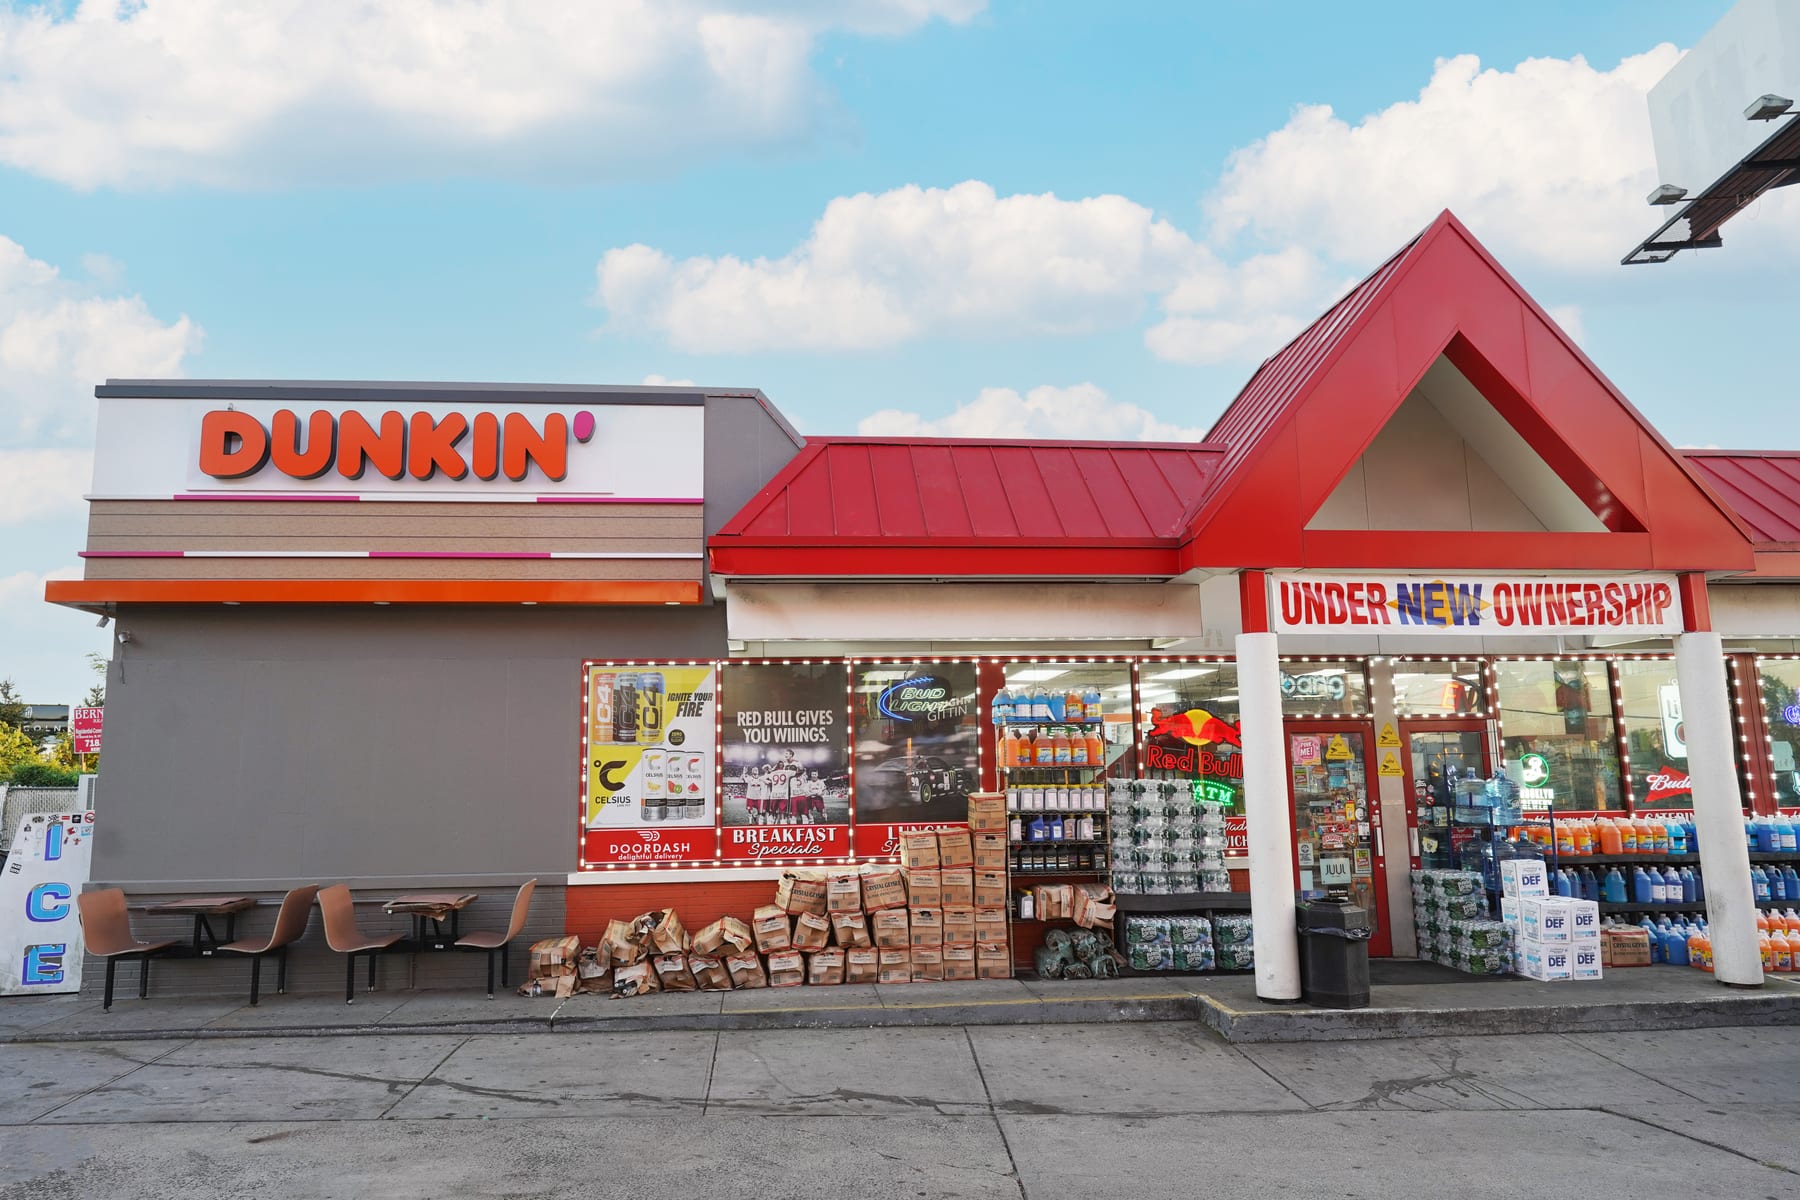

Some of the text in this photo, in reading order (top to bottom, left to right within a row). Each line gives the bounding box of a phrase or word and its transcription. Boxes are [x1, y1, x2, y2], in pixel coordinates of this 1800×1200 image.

[199, 409, 596, 482] DUNKIN'
[1280, 581, 1672, 628] UNDER NEW OWNERSHIP
[667, 692, 713, 702] IGNITE YOUR
[900, 687, 946, 700] BUD
[597, 684, 611, 723] C4
[643, 684, 659, 729] C4
[676, 701, 704, 718] FIRE
[889, 699, 946, 712] LIGHT
[737, 710, 833, 726] RED BULL GIVES
[927, 705, 968, 722] GITTIN
[743, 727, 829, 743] YOU WIIINGS.
[1299, 747, 1313, 756] ME!
[1146, 745, 1244, 779] Red Bull
[772, 774, 787, 786] 99
[595, 796, 631, 804] CELSIUS
[1194, 784, 1232, 803] ATM
[733, 828, 837, 844] BREAKFAST
[610, 843, 690, 854] DOORDASH
[748, 841, 823, 859] Specials
[655, 853, 683, 861] delivery
[1325, 863, 1346, 876] JUUL
[1522, 875, 1541, 886] DEF
[22, 821, 71, 986] ICE
[1546, 918, 1565, 929] DEF
[1576, 915, 1593, 926] DEF
[1548, 957, 1567, 967] DEF
[1577, 954, 1595, 965] DEF
